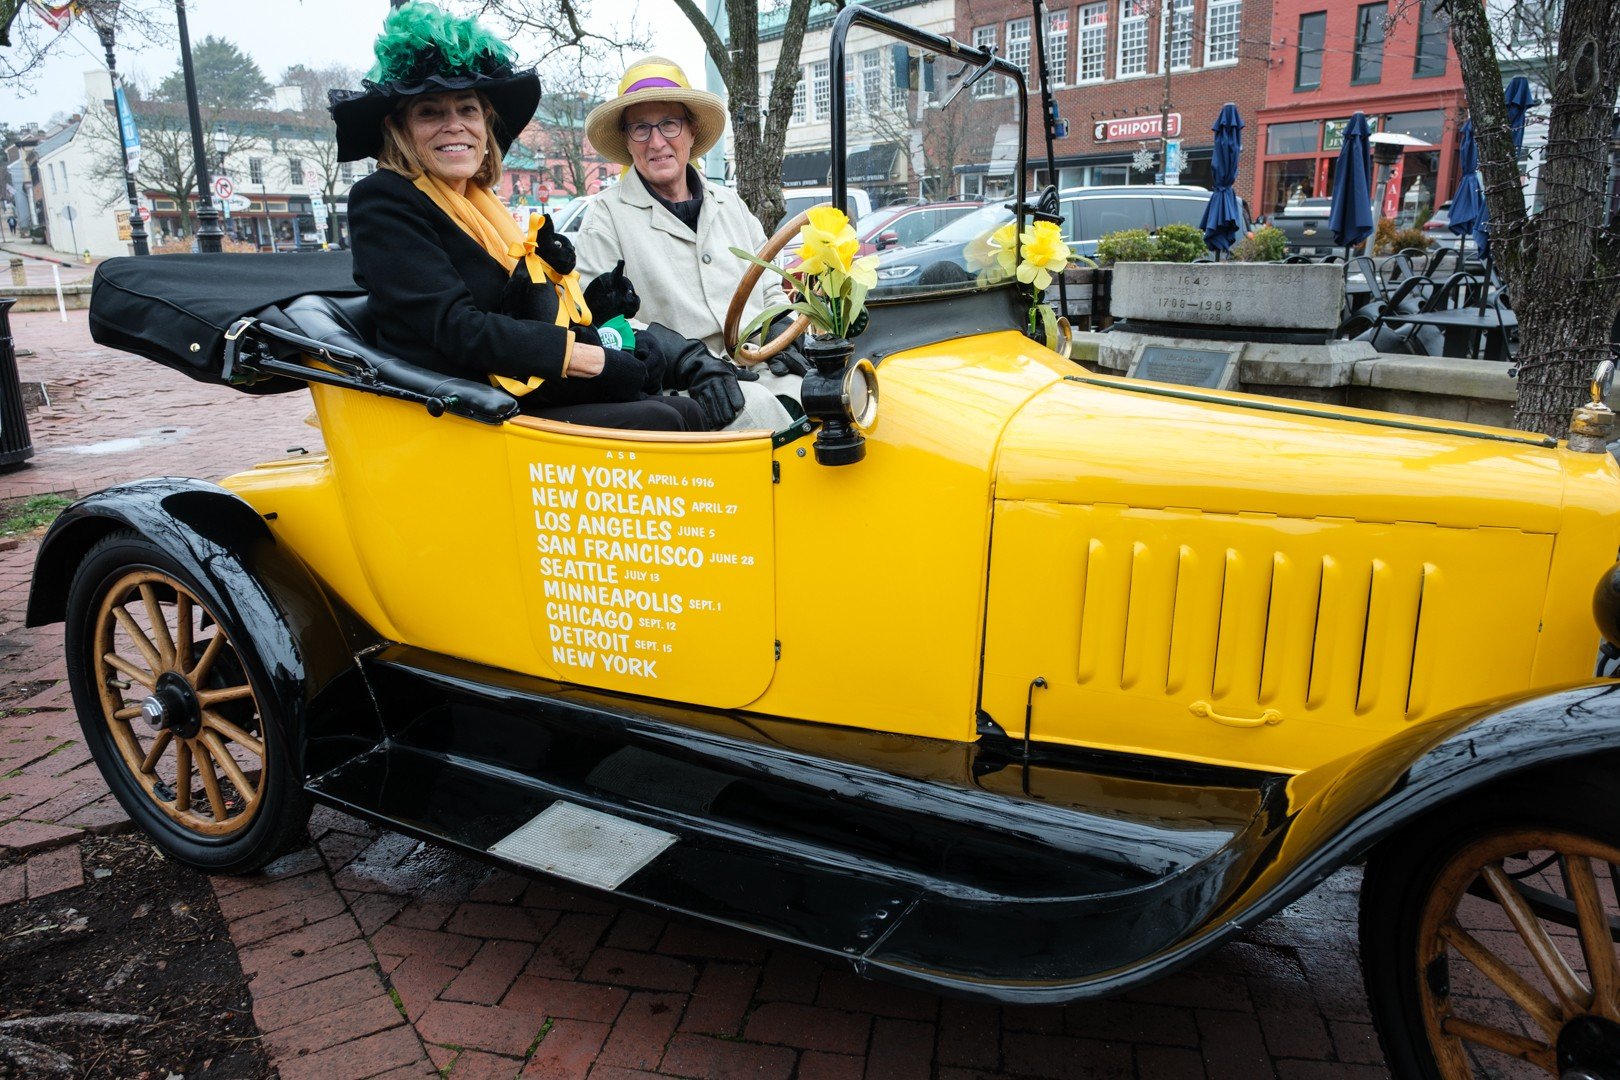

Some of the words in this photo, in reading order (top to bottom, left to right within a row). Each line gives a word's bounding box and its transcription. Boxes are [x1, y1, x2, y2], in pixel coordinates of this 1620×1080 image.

[1109, 119, 1174, 137] CHIPOTLE
[529, 463, 576, 485] NEW
[582, 465, 643, 490] YORK
[648, 474, 679, 486] APRIL
[681, 477, 689, 486] 6
[691, 477, 715, 488] 1916
[532, 487, 579, 509] NEW
[585, 491, 685, 518] ORLEANS
[691, 501, 723, 513] APRIL
[725, 504, 738, 514] 27
[535, 510, 571, 532] LOS
[577, 515, 672, 541] ANGELES
[677, 526, 705, 537] JUNE
[708, 529, 716, 538] 5
[537, 534, 577, 556] SAN
[584, 539, 704, 568] FRANCISCO
[709, 553, 738, 564] JUNE
[741, 555, 755, 565] 28
[540, 556, 619, 584] SEATTLE
[624, 570, 647, 582] JULY
[650, 573, 660, 582] 13
[543, 580, 683, 614] MINNEAPOLIS
[689, 599, 715, 610] SEPT.
[717, 602, 721, 611] 1
[546, 602, 633, 631] CHICAGO
[638, 618, 664, 629] SEPT.
[666, 621, 677, 631] 12
[549, 624, 629, 652] DETROIT
[634, 639, 660, 651] SEPT.
[662, 643, 673, 653] 15
[552, 646, 595, 669] NEW
[601, 654, 658, 679] YORK
